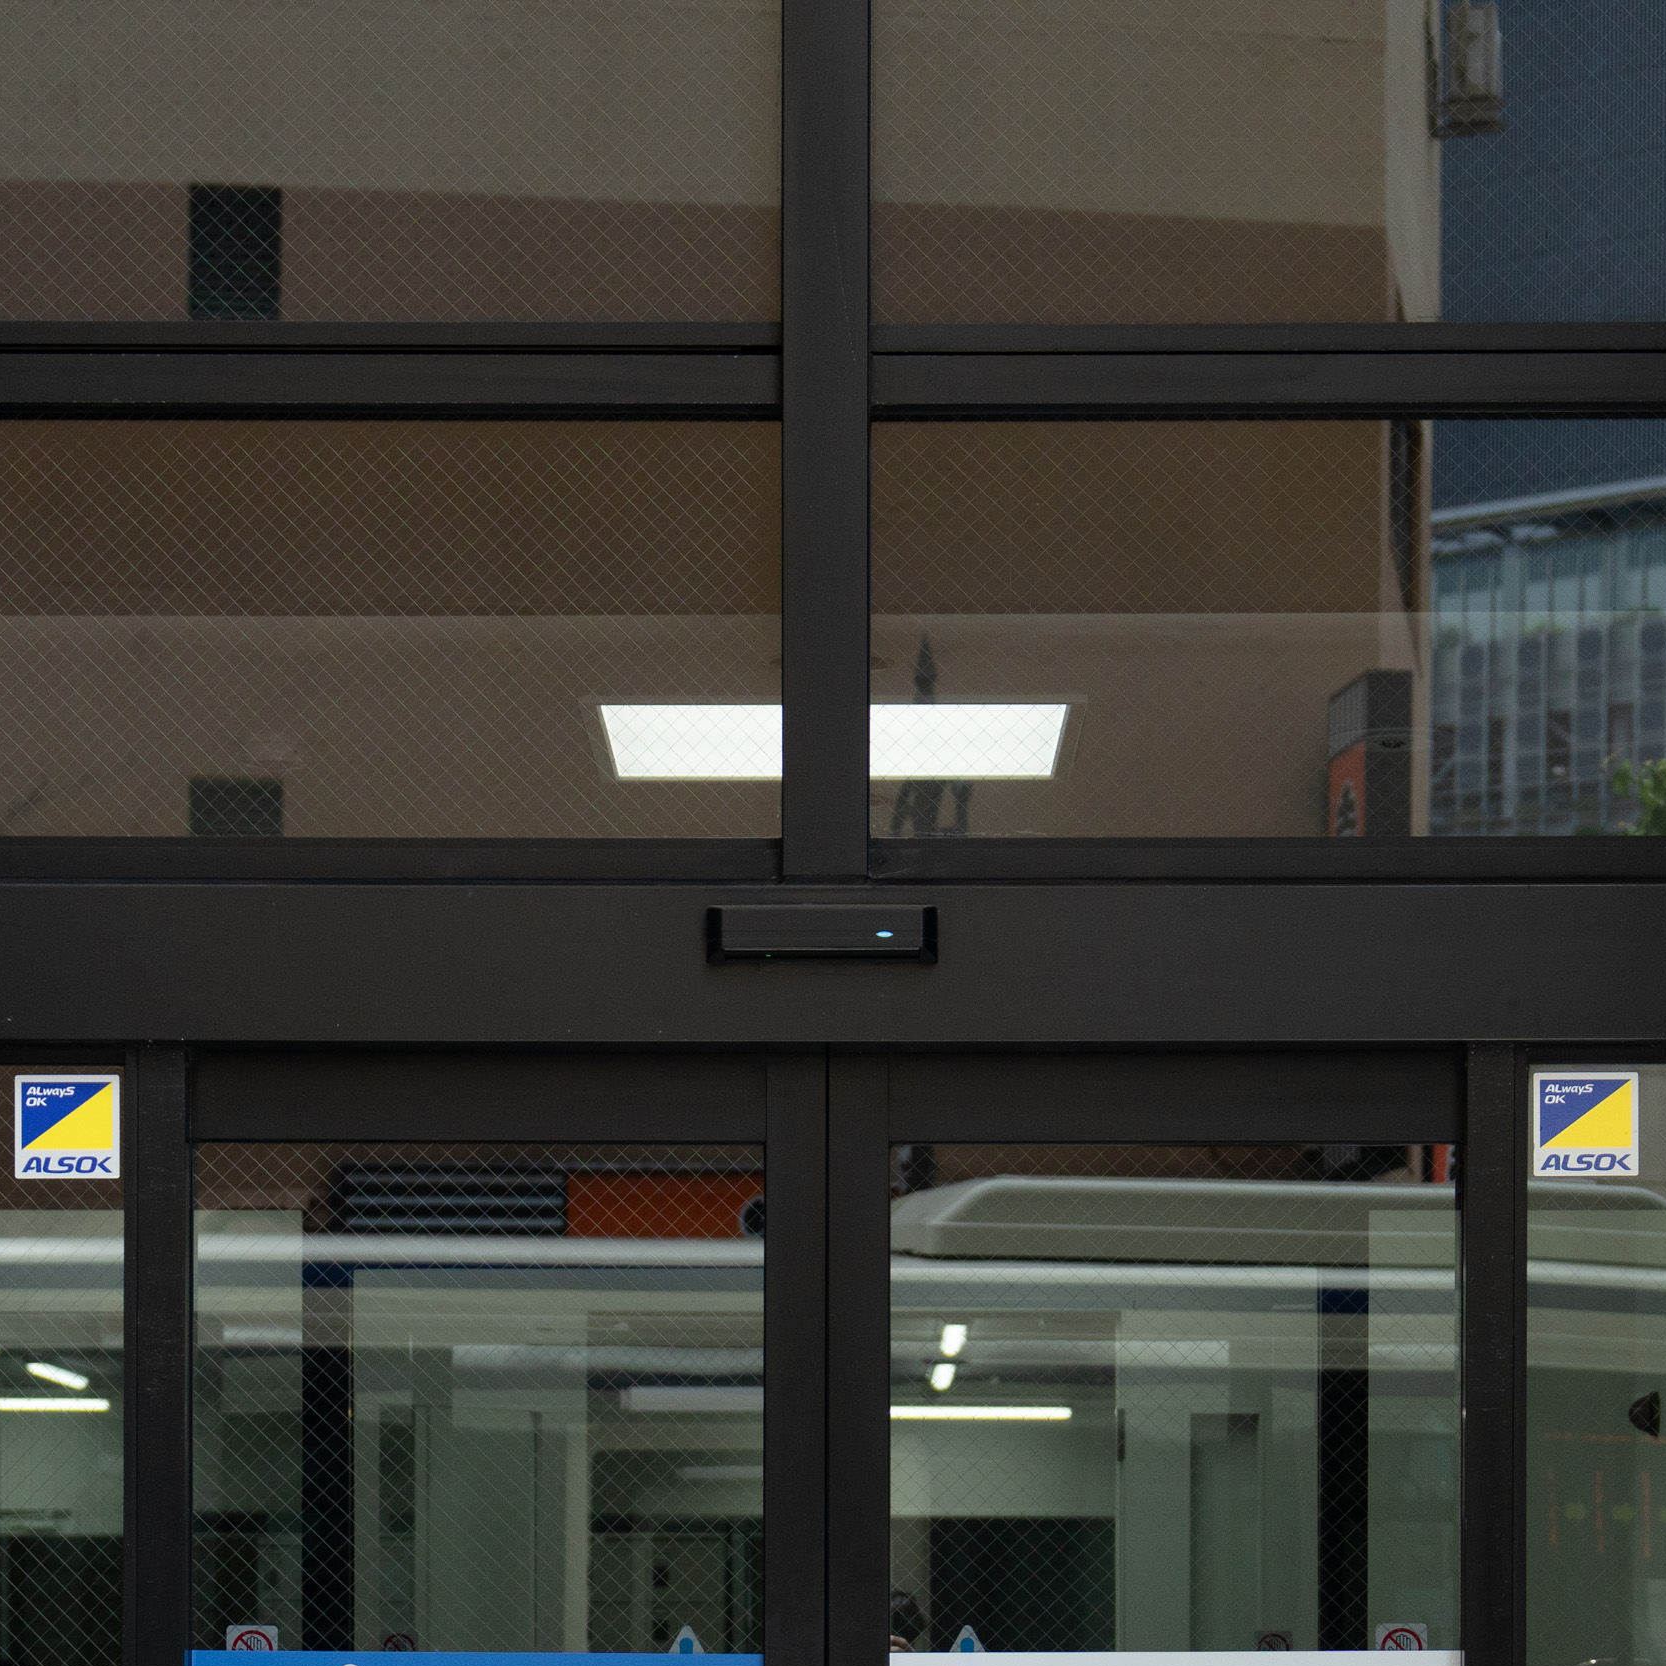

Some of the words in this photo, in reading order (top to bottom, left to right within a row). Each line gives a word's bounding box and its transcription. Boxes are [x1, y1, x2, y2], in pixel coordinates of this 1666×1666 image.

[25, 1097, 48, 1107] OK
[1544, 1094, 1566, 1104] OK
[21, 1155, 113, 1174] ALSOK
[1540, 1153, 1632, 1172] ALSOK
